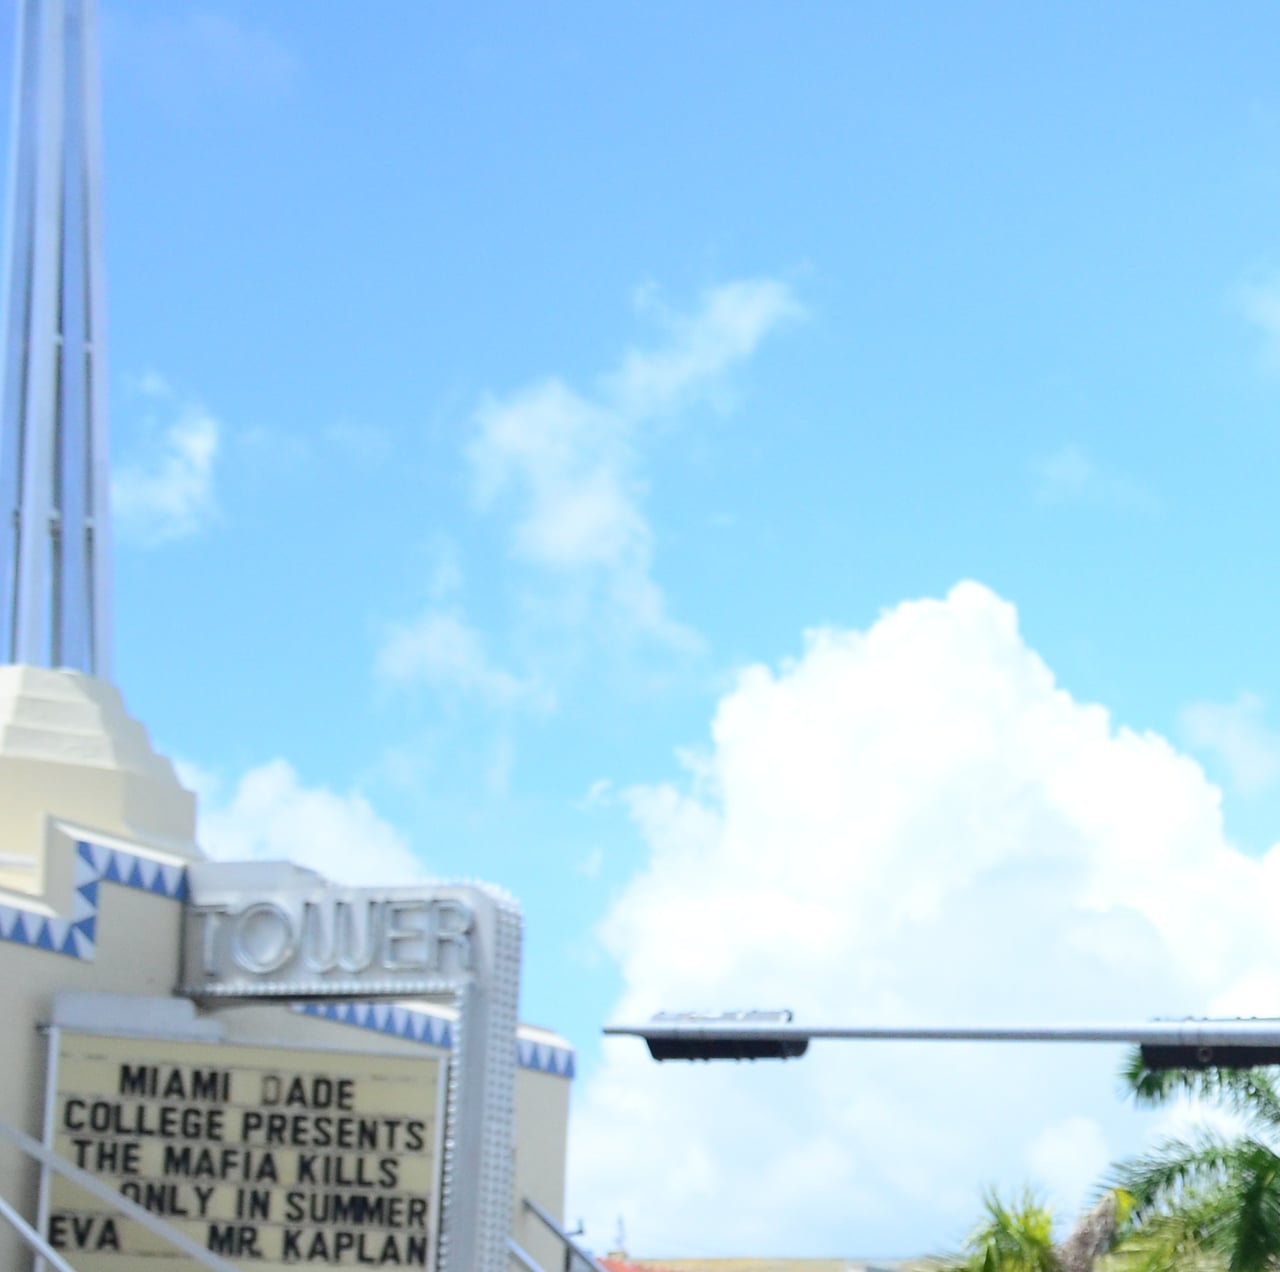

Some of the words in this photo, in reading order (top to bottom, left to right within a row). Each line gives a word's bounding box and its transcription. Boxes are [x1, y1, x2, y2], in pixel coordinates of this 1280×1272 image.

[188, 897, 472, 974] TOWER
[119, 1064, 230, 1104] MIAMI
[262, 1074, 354, 1110] DADE
[64, 1099, 224, 1141] COLLEGE
[242, 1111, 426, 1151] PRESENTS
[71, 1139, 140, 1175] THE
[164, 1146, 278, 1182] MAFIA
[297, 1154, 398, 1189] KILLS
[236, 1188, 270, 1222] IN
[285, 1191, 427, 1231] SUMMER
[49, 1214, 120, 1249] EVA
[282, 1228, 428, 1267] KAPLAN
